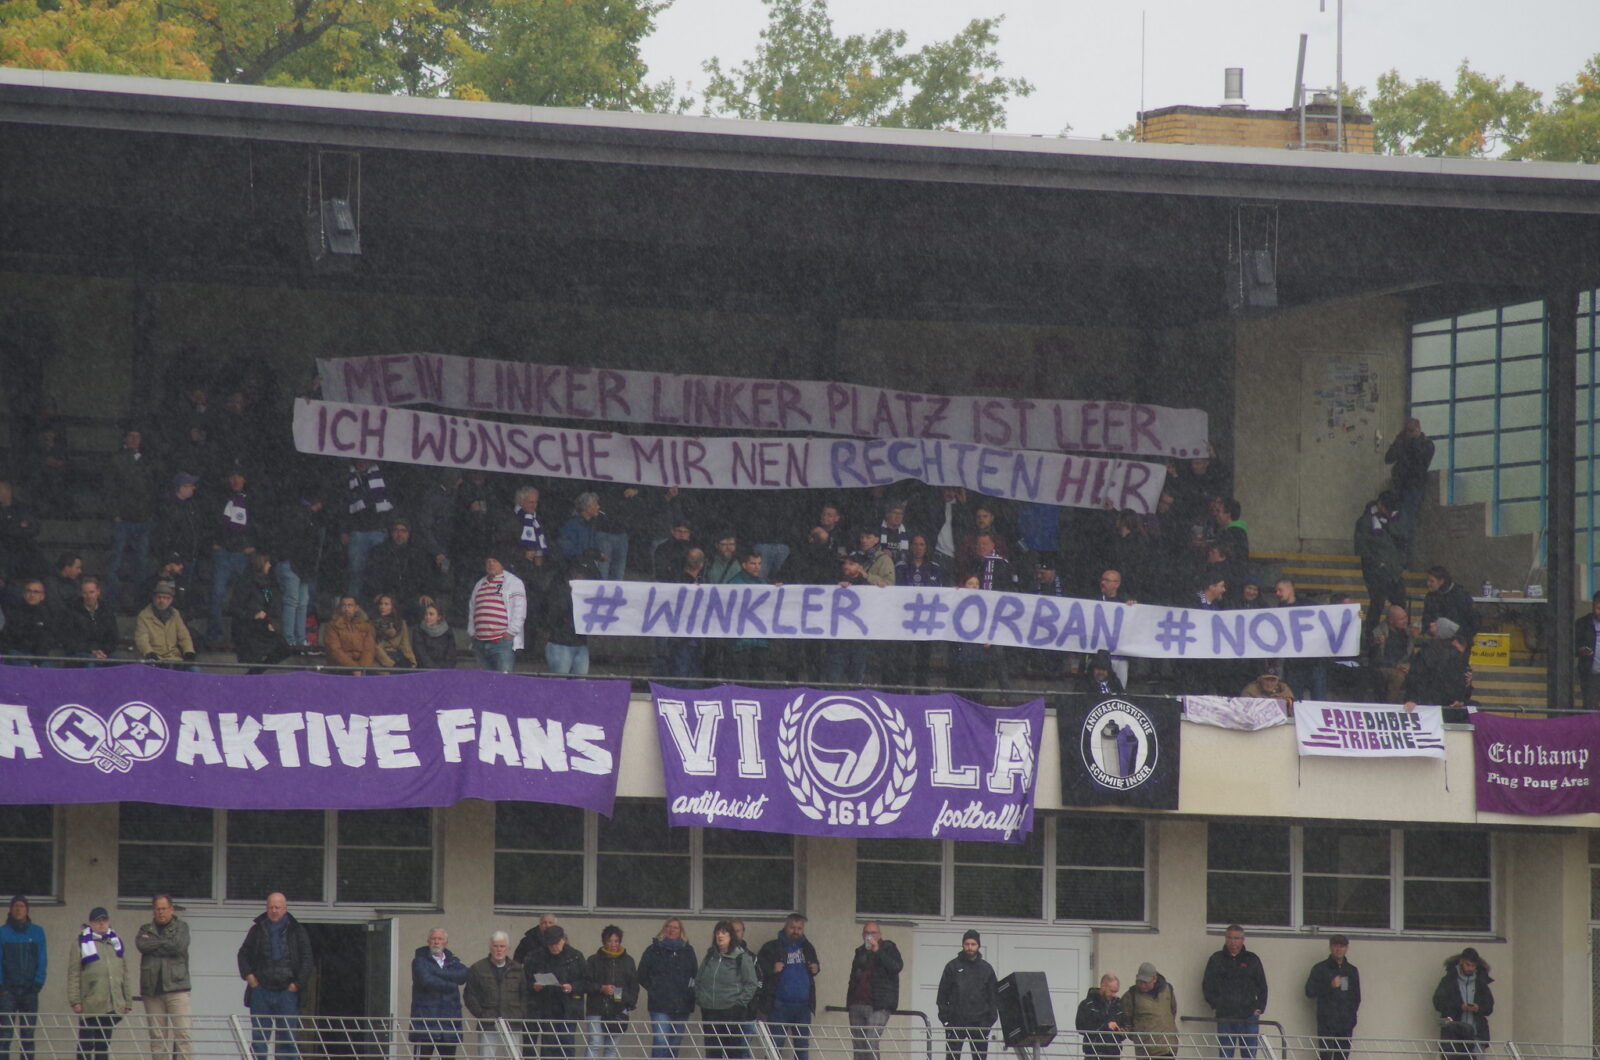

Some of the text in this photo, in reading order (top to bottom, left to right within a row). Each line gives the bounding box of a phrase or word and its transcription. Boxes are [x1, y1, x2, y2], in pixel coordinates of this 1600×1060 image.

[467, 358, 632, 417] LINKER
[653, 375, 811, 430] LINKER
[827, 381, 951, 440] PLATZ
[972, 400, 1037, 448] IST
[317, 405, 388, 459] ICH
[411, 412, 614, 481] WÜNSCHE
[629, 437, 714, 486] MIR
[731, 440, 810, 488] NEN
[830, 438, 1044, 498] RECHTEN
[902, 592, 1125, 653] #ORBAN
[1085, 702, 1153, 736] ANTIFASCHISTISCHE
[176, 710, 421, 771] AKTIVE
[436, 708, 614, 776] FANS
[1488, 741, 1590, 770] Eichkamp
[1487, 772, 1590, 791] Ping Pong Area
[671, 790, 769, 824] antifascist
[828, 800, 870, 826] 161
